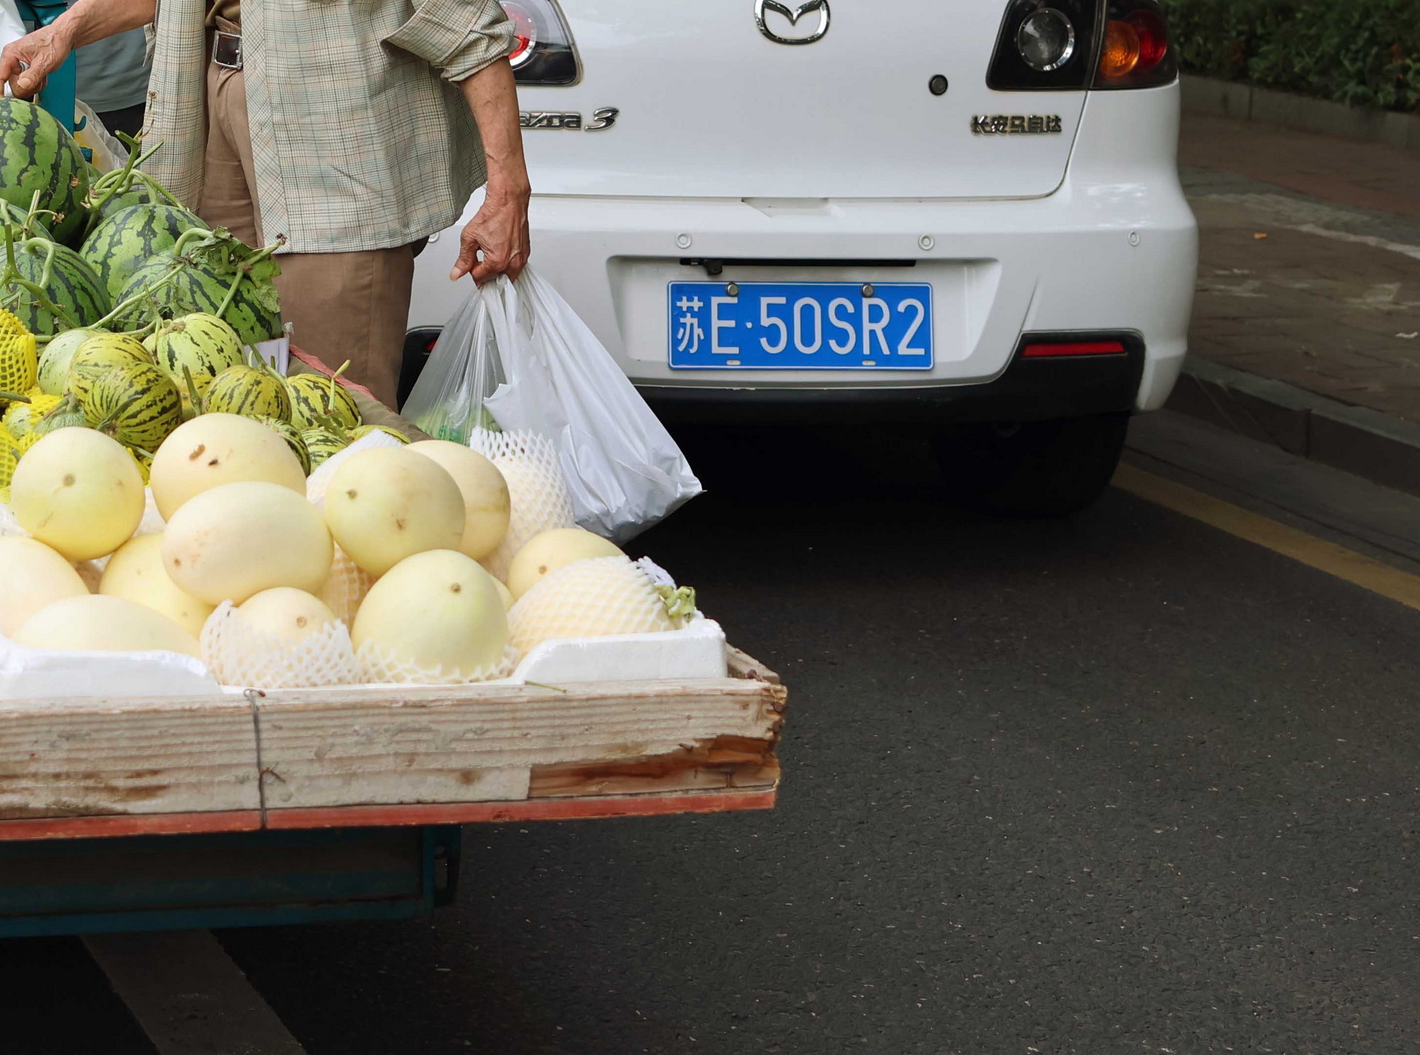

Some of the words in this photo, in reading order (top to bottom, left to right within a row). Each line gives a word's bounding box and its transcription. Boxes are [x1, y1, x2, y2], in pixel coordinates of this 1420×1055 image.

[519, 111, 581, 131] azda
[584, 107, 619, 132] 3
[971, 114, 1063, 135] 长安马自达
